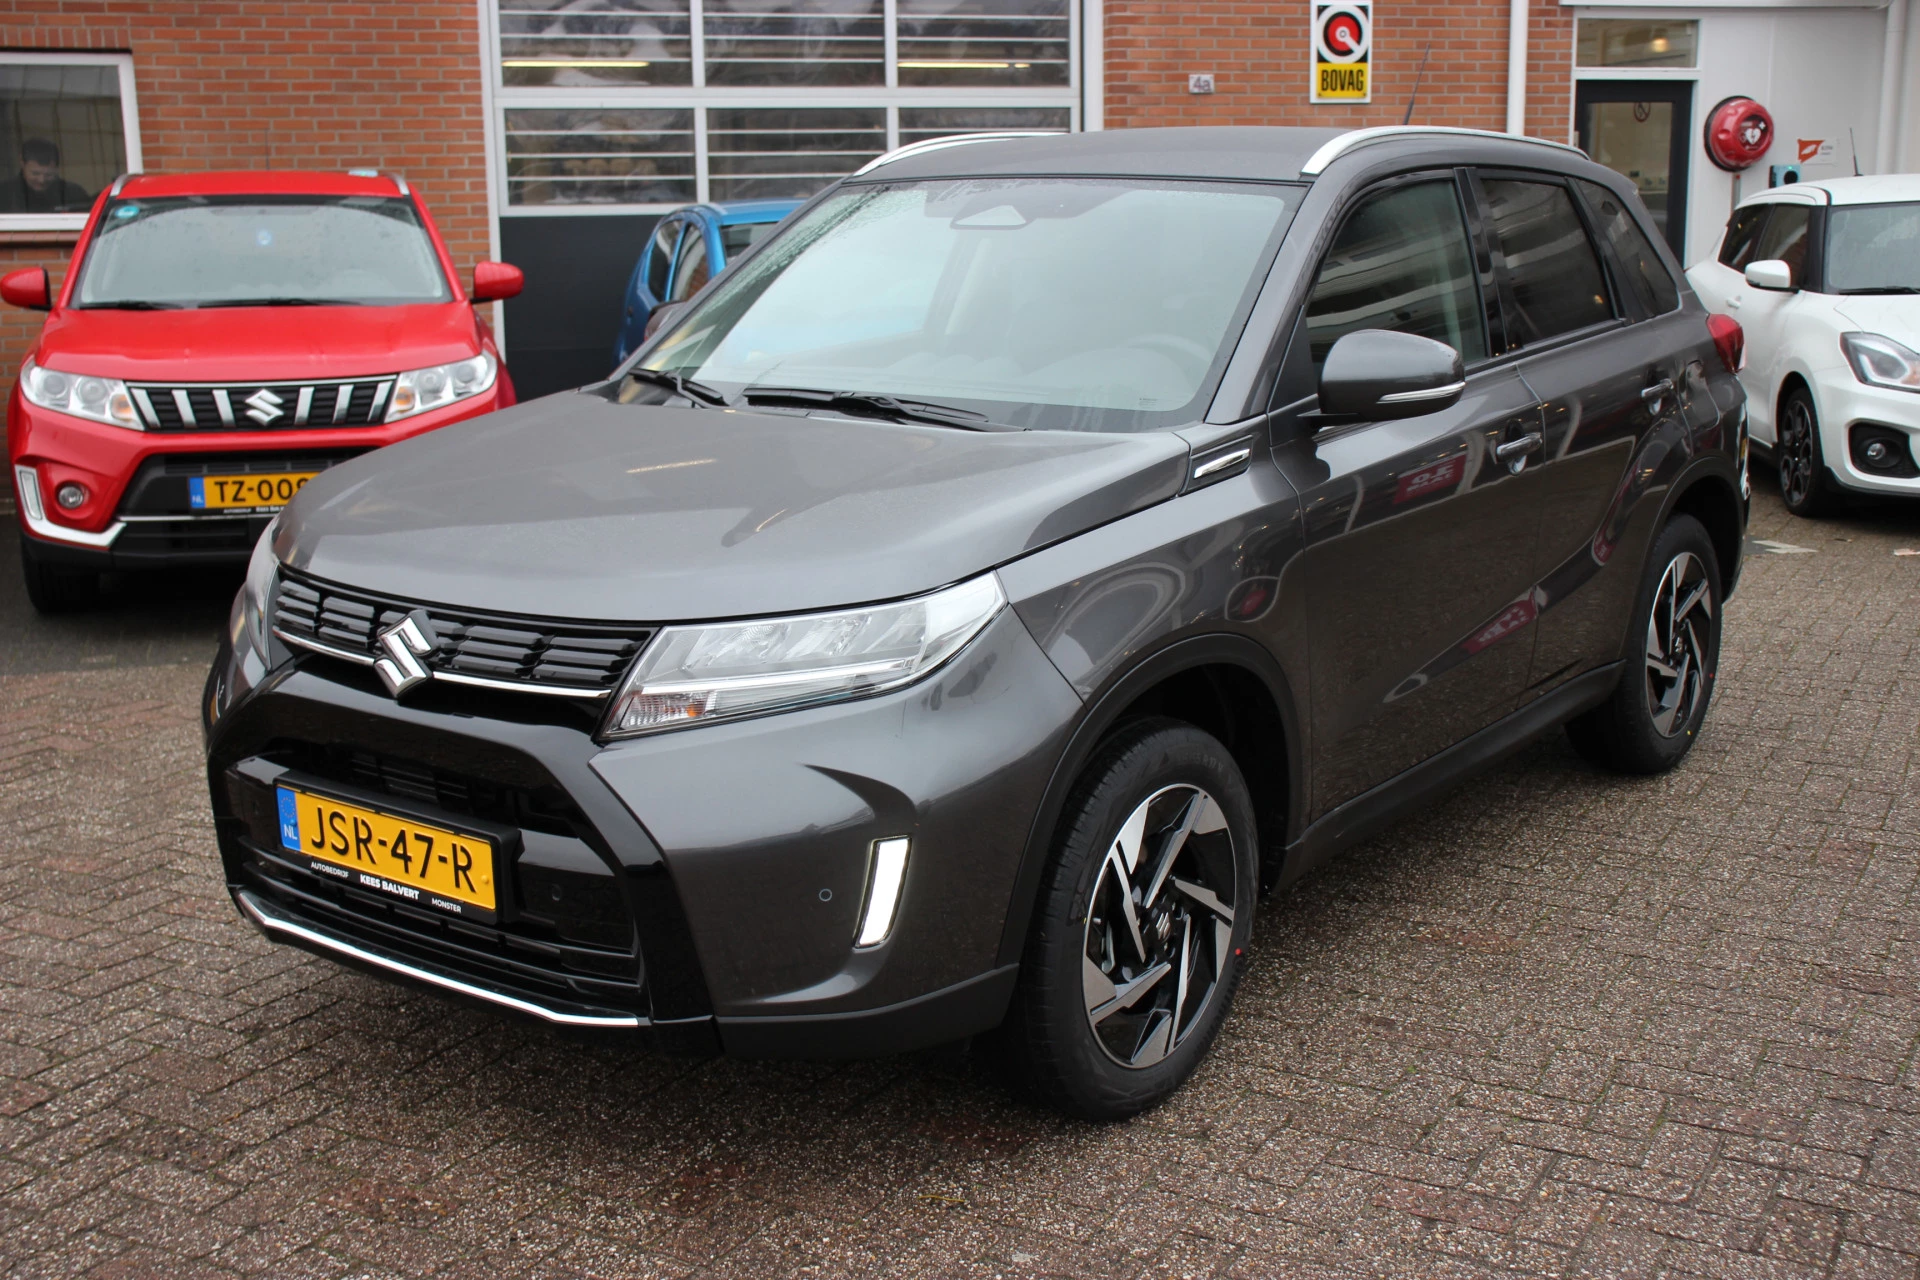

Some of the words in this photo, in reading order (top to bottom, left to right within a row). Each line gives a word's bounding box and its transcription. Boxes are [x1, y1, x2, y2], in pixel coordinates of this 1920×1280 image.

[1193, 76, 1211, 92] 4a
[1321, 69, 1364, 91] BOVAG
[284, 824, 298, 840] NL
[311, 807, 477, 894] JSR-47-R
[311, 861, 349, 878] AUTOBEDRIJF
[360, 873, 381, 889] KEES
[381, 881, 420, 900] BALVERT
[431, 897, 462, 914] MONSTER
